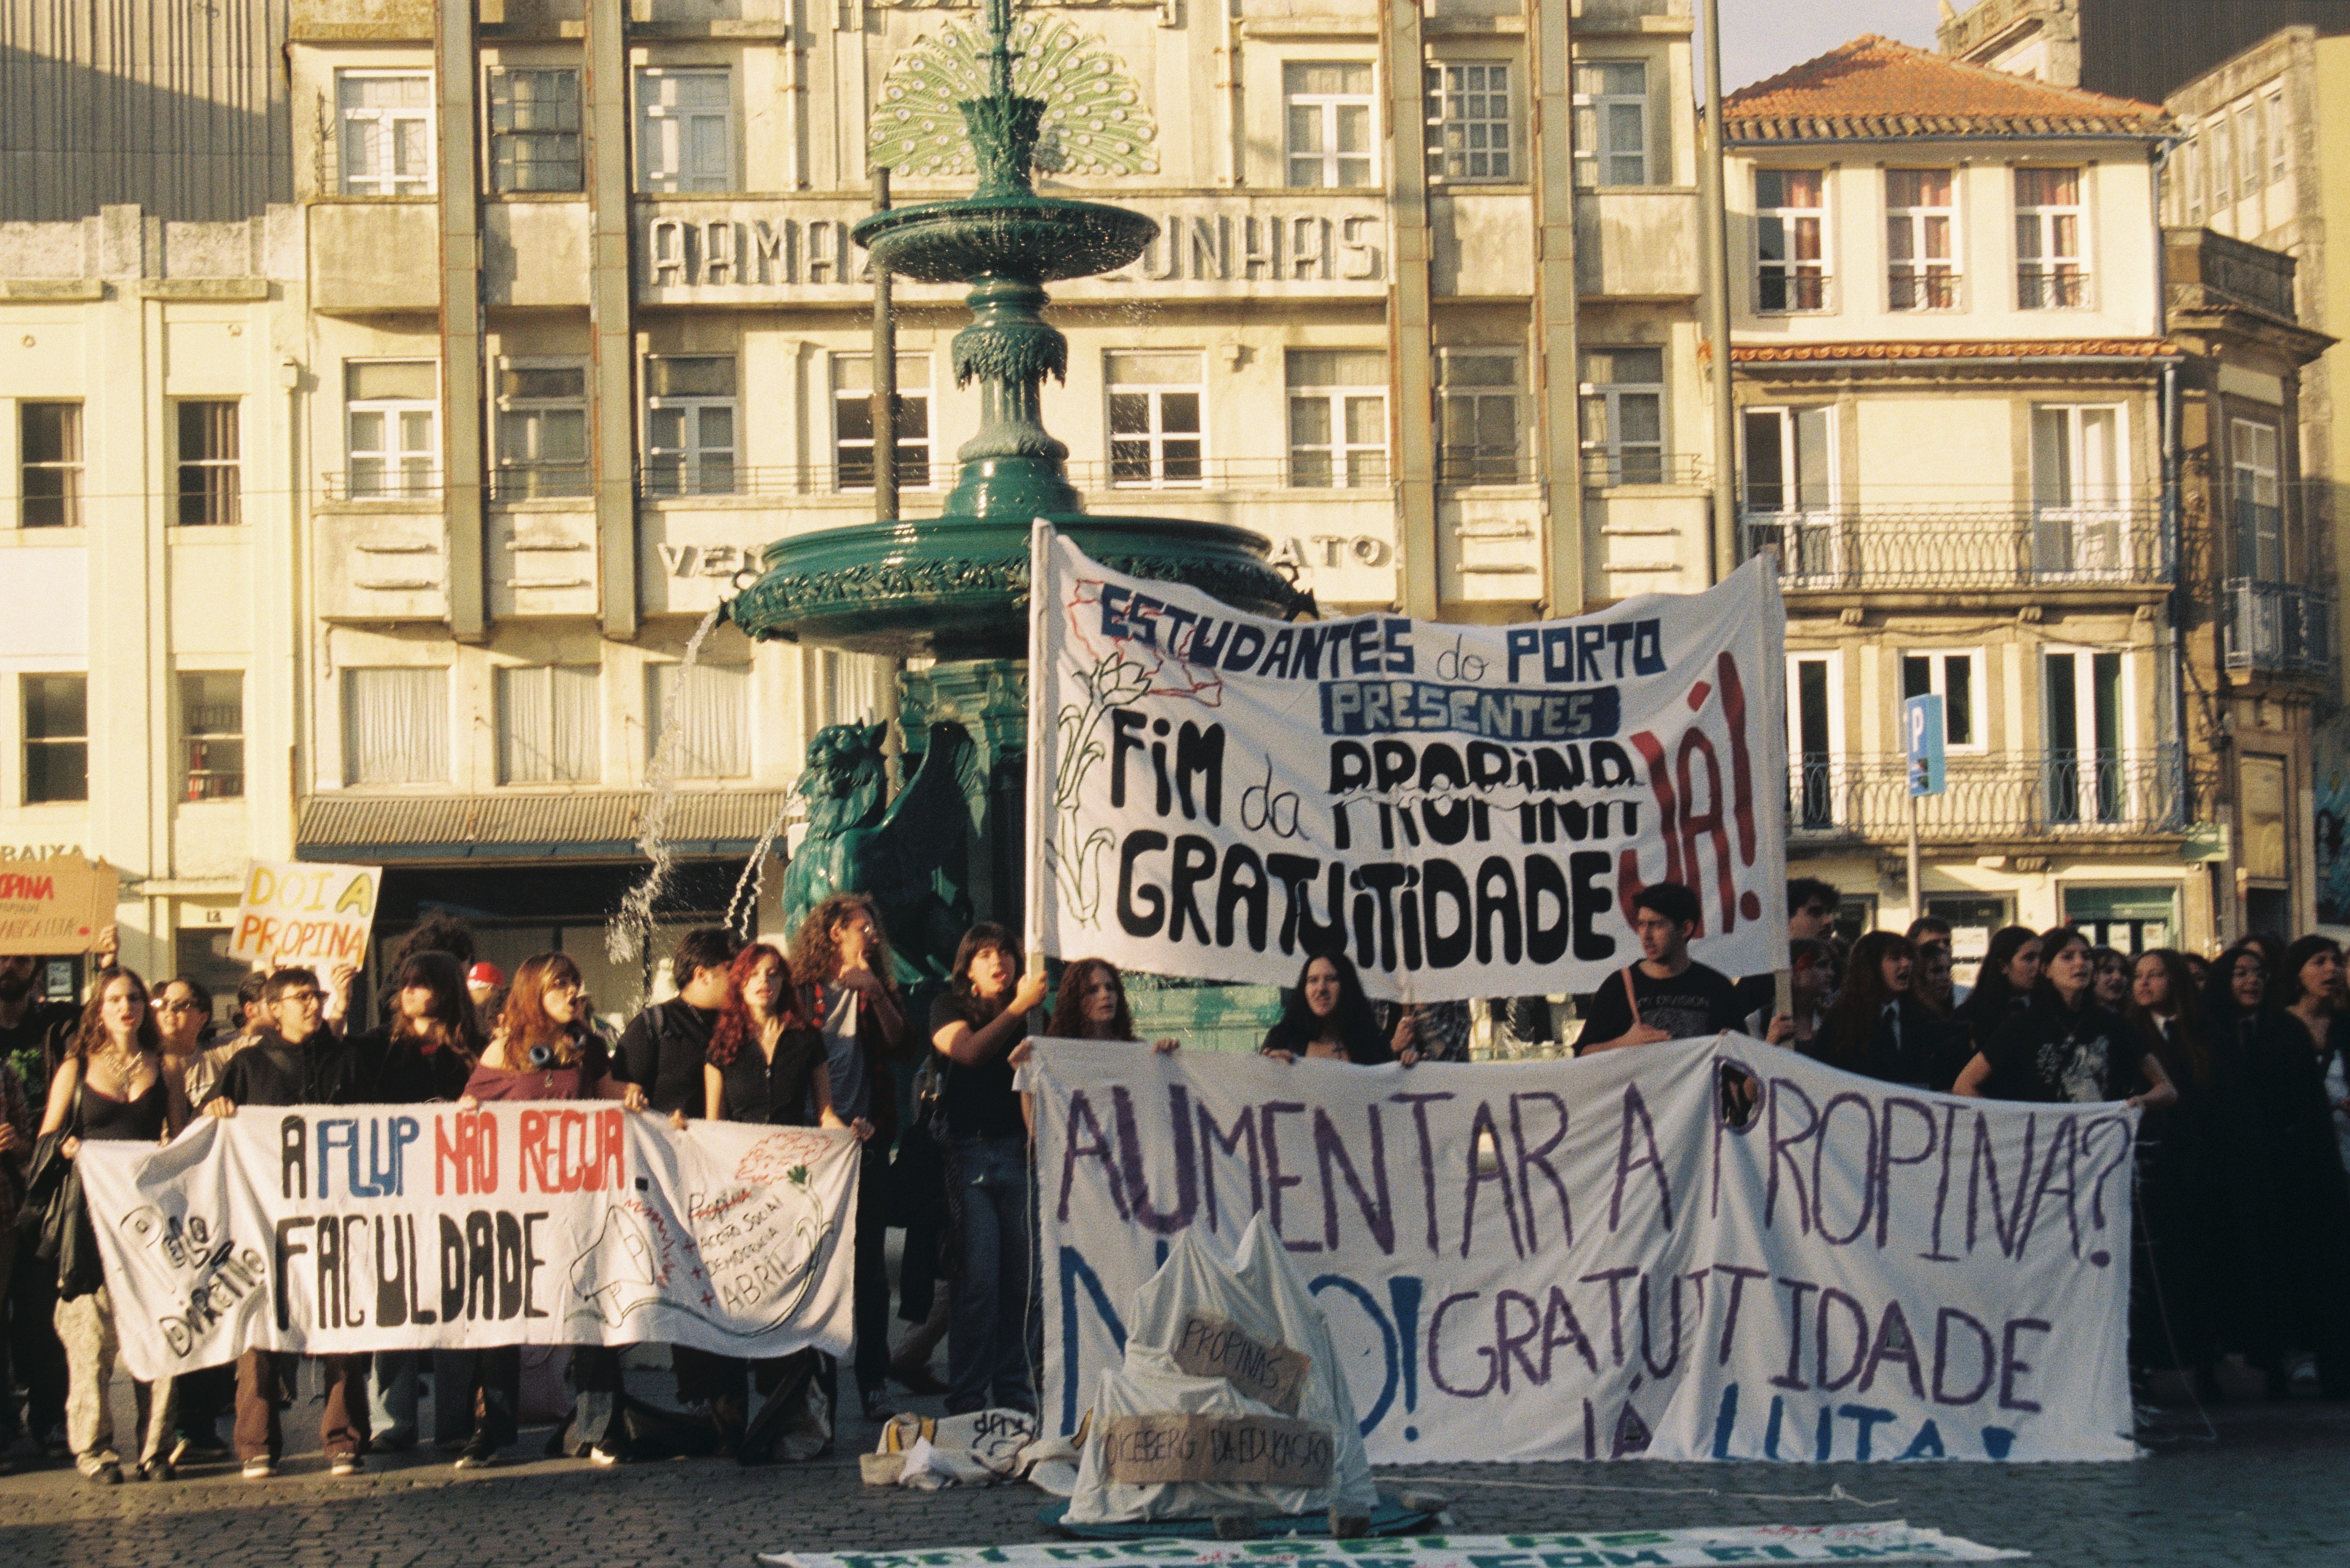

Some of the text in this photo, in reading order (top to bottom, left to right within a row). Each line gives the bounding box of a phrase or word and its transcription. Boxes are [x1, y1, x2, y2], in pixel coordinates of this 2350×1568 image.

[1115, 213, 1387, 281] UNHAS
[1265, 535, 1392, 568] ATO
[1101, 583, 1667, 683] ESTUDANTES do PORTO
[1331, 680, 1595, 739] PRESENTES
[1912, 706, 1924, 753] P
[1241, 753, 1310, 840] da
[1618, 651, 1761, 939] JÁ!
[248, 867, 373, 917] DOI A
[236, 914, 365, 966] PROPINA
[281, 1114, 307, 1199] A
[317, 1116, 420, 1200] FLUP
[1058, 1054, 2131, 1268] AUMENTAR A PROPINA?
[276, 1210, 550, 1331] FACULDADE
